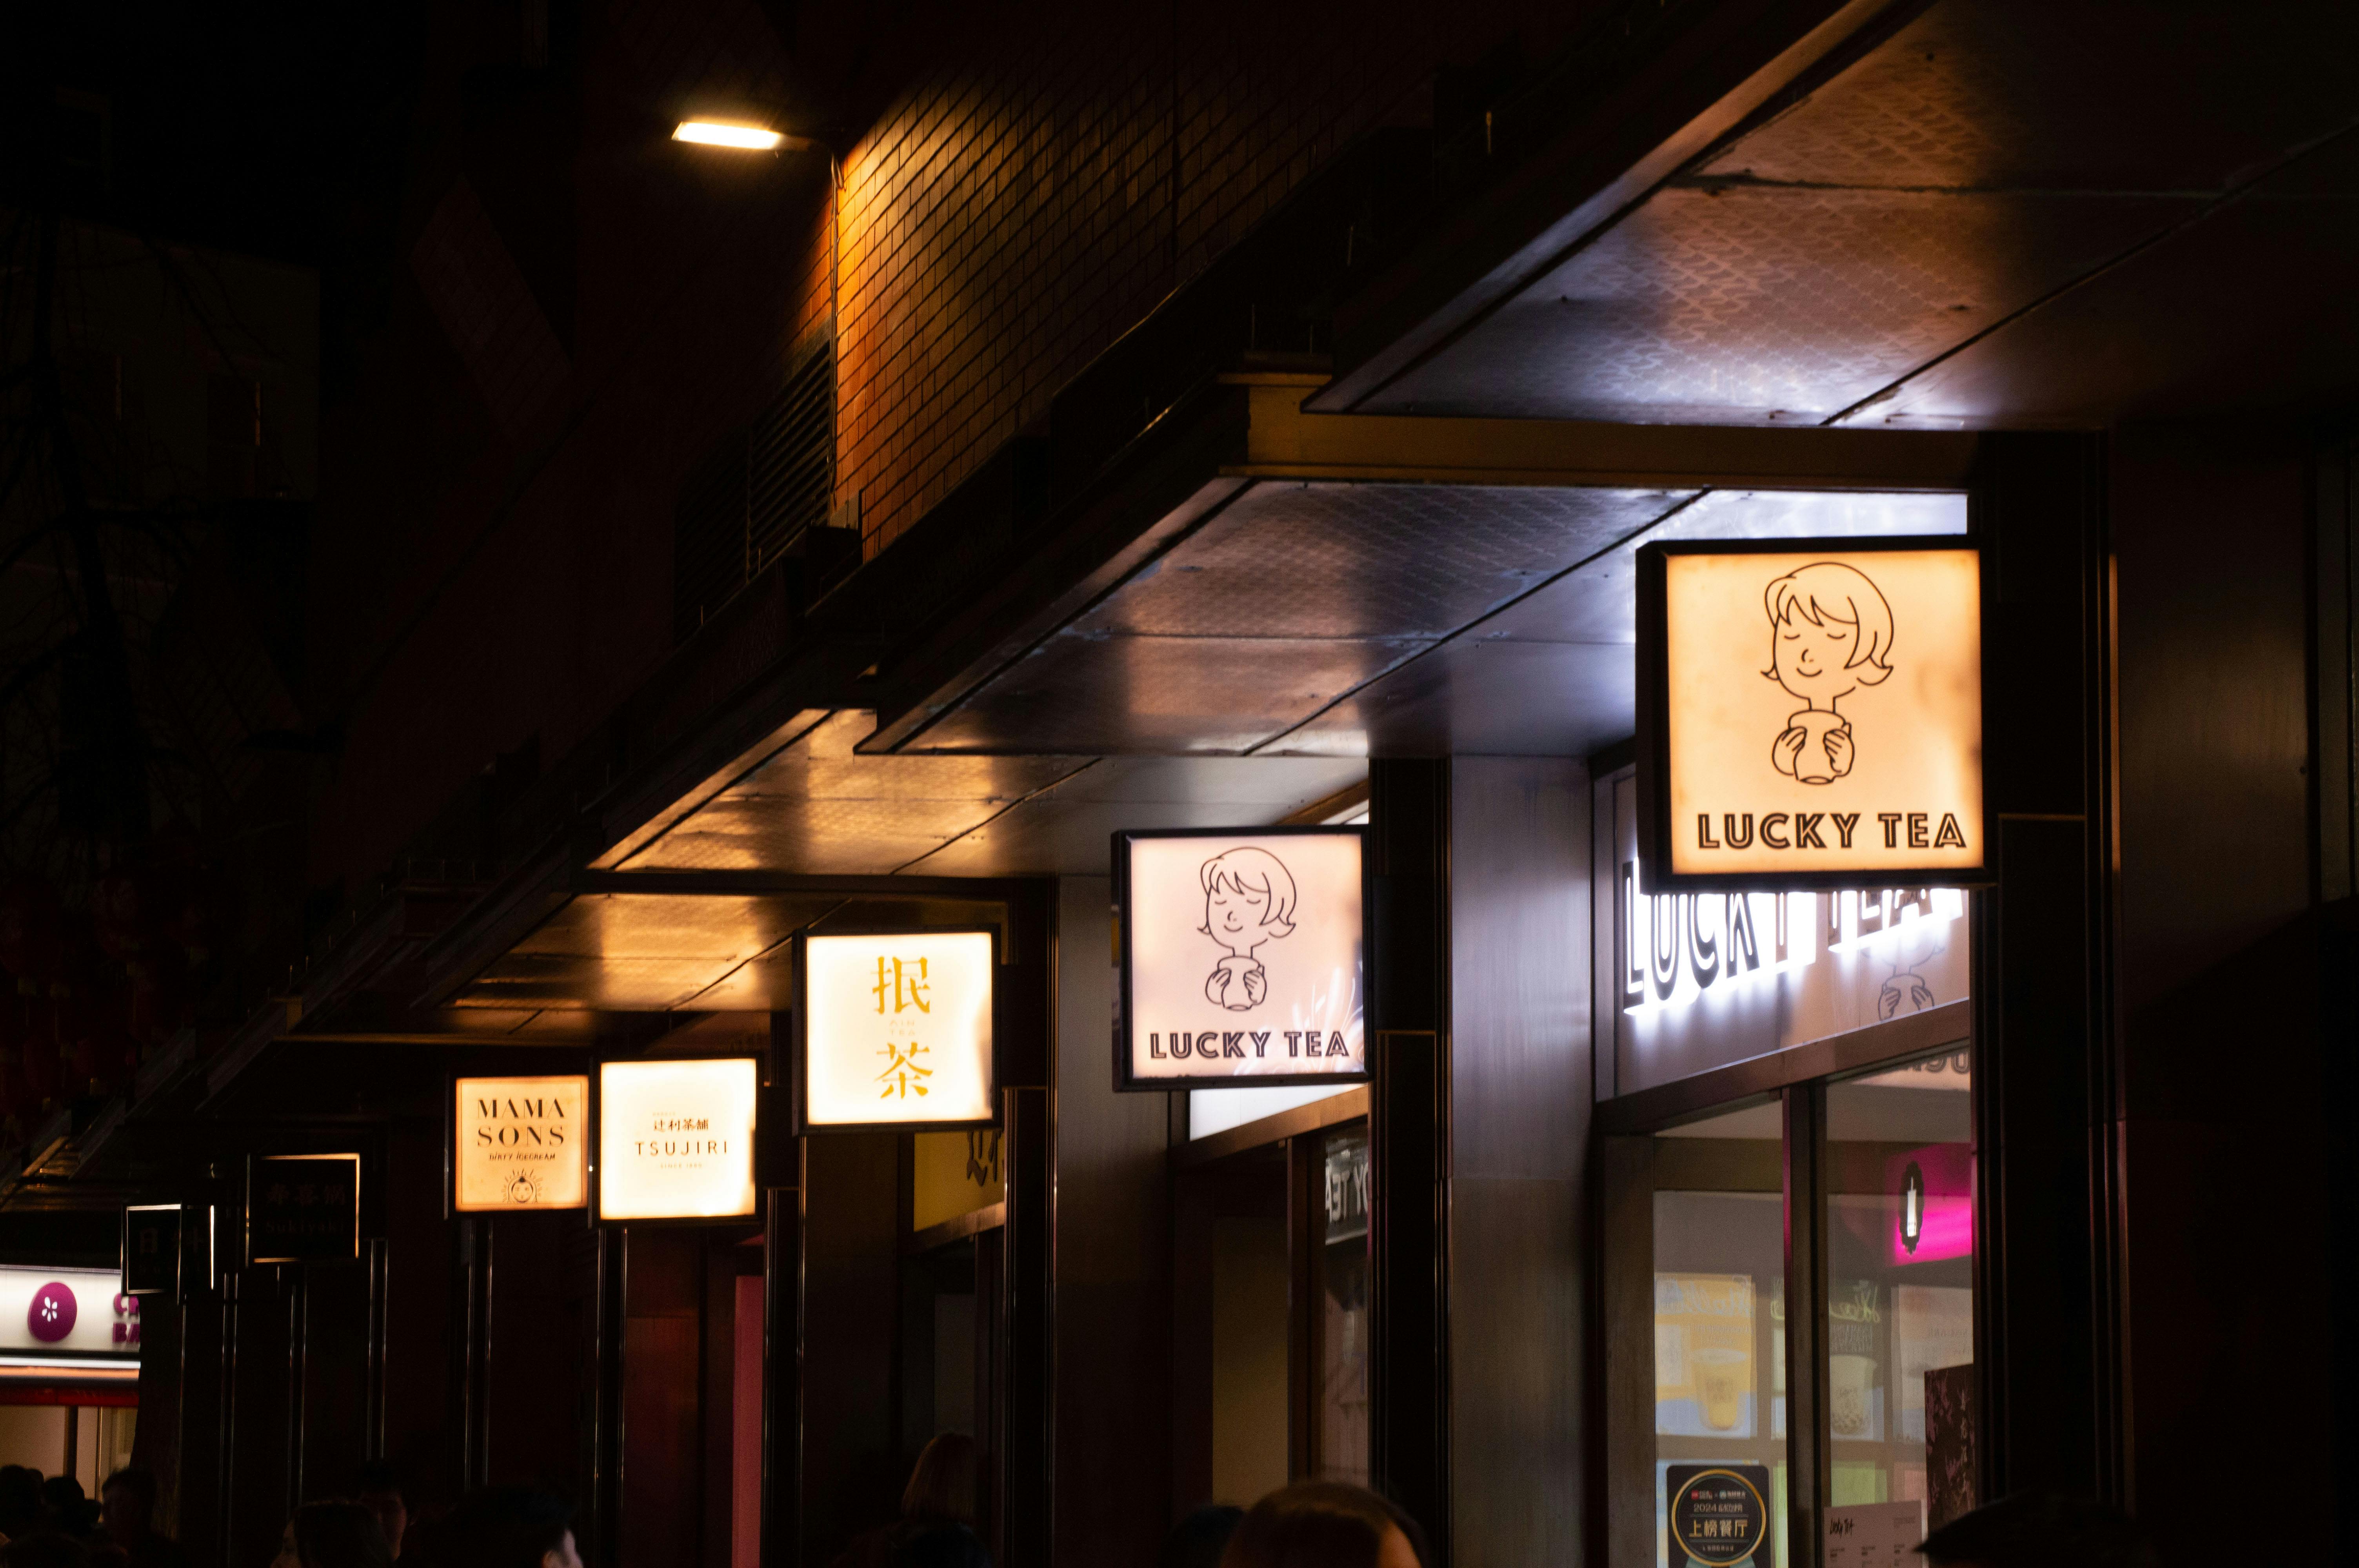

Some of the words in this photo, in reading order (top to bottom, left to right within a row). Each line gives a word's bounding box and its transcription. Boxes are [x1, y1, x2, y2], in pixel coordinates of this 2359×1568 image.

[1697, 813, 1861, 850] LUCKY
[1877, 812, 1967, 849] TEA
[1150, 1031, 1271, 1060] LUCKY
[1283, 1031, 1350, 1058] TEA
[477, 1098, 565, 1119] MAMA
[477, 1125, 564, 1148] SONS
[489, 1151, 514, 1161] DIRTY
[516, 1151, 556, 1161] ICECREAM
[635, 1140, 727, 1156] TSUJIRI
[1694, 1503, 1716, 1512] 2024
